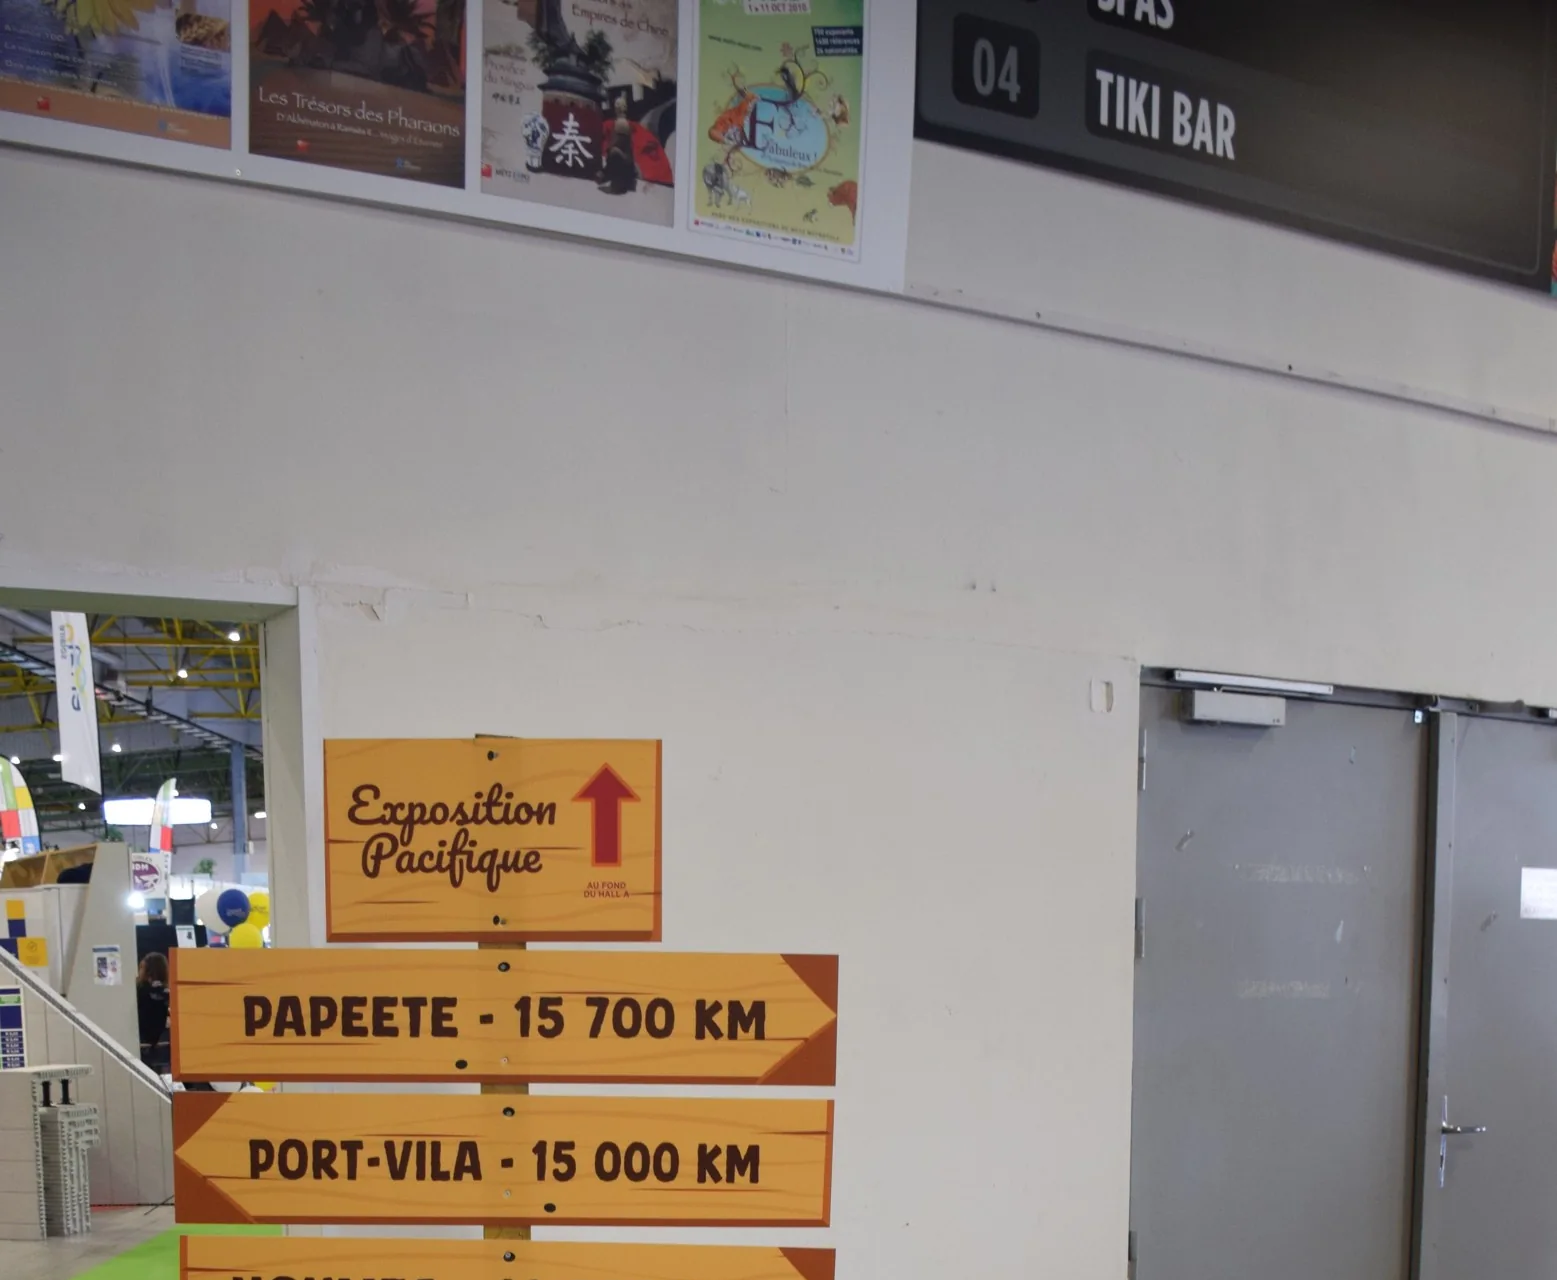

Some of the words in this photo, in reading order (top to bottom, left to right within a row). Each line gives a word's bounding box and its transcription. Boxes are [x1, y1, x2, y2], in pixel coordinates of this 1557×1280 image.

[572, 3, 618, 26] Empires
[620, 12, 635, 30] de
[637, 17, 670, 38] Chine
[972, 37, 1021, 102] 04
[259, 86, 288, 106] Les
[292, 92, 352, 118] Trésors
[355, 101, 383, 123] des
[388, 107, 460, 137] Pharaons
[1096, 69, 1160, 139] TIKI
[1173, 91, 1236, 160] BAR
[348, 783, 557, 847] Exposition
[361, 828, 543, 893] Pacifique
[583, 890, 597, 899] DU
[598, 890, 621, 899] HALL
[586, 881, 600, 890] AU
[601, 881, 627, 890] FOND
[244, 995, 459, 1038] PAPEETE
[479, 1014, 494, 1025] -
[514, 996, 565, 1039] 15
[586, 997, 676, 1040] 700
[694, 1000, 767, 1041] KM
[248, 1138, 483, 1182] PORT-VILA
[500, 1158, 514, 1169] -
[532, 1140, 577, 1182] 15
[594, 1142, 680, 1183] 000
[697, 1143, 761, 1184] KM
